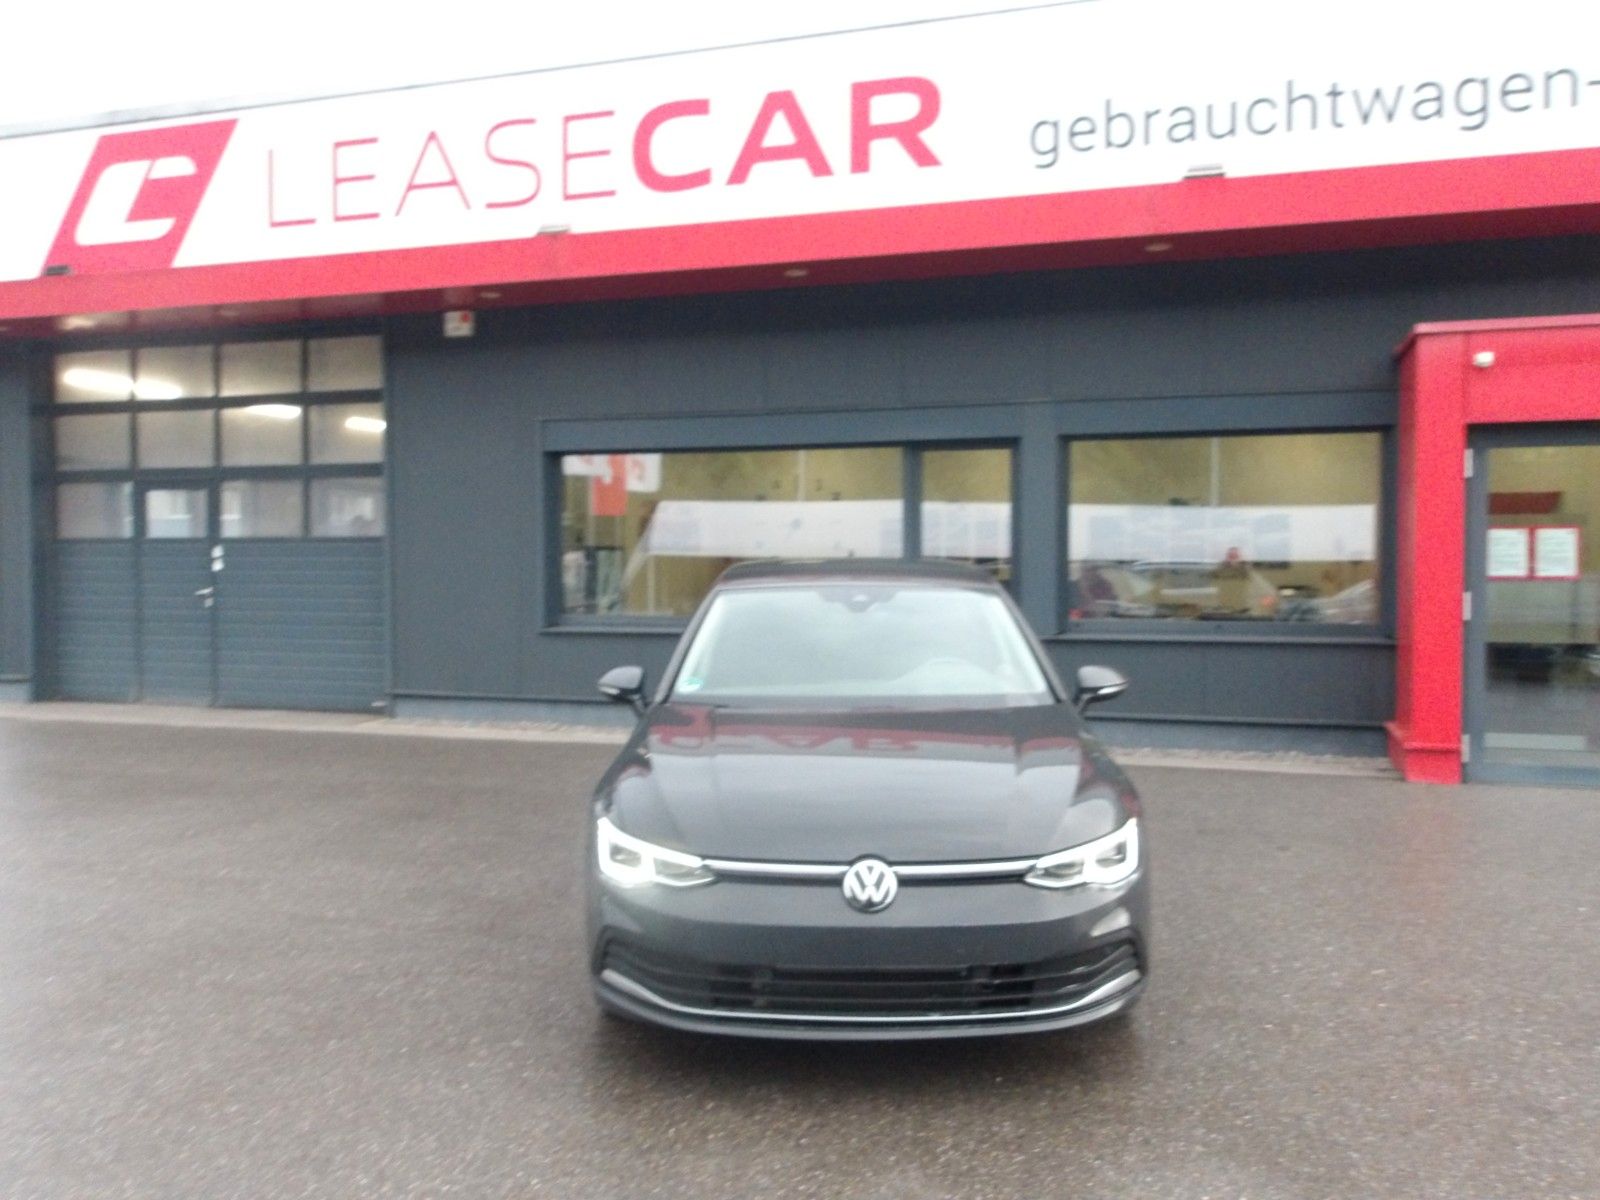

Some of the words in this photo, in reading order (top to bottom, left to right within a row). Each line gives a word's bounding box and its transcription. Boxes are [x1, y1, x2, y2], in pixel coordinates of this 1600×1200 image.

[267, 76, 942, 228] LEASECAR
[1030, 67, 1600, 169] gebrauchtwagen-
[842, 857, 898, 911] VW
